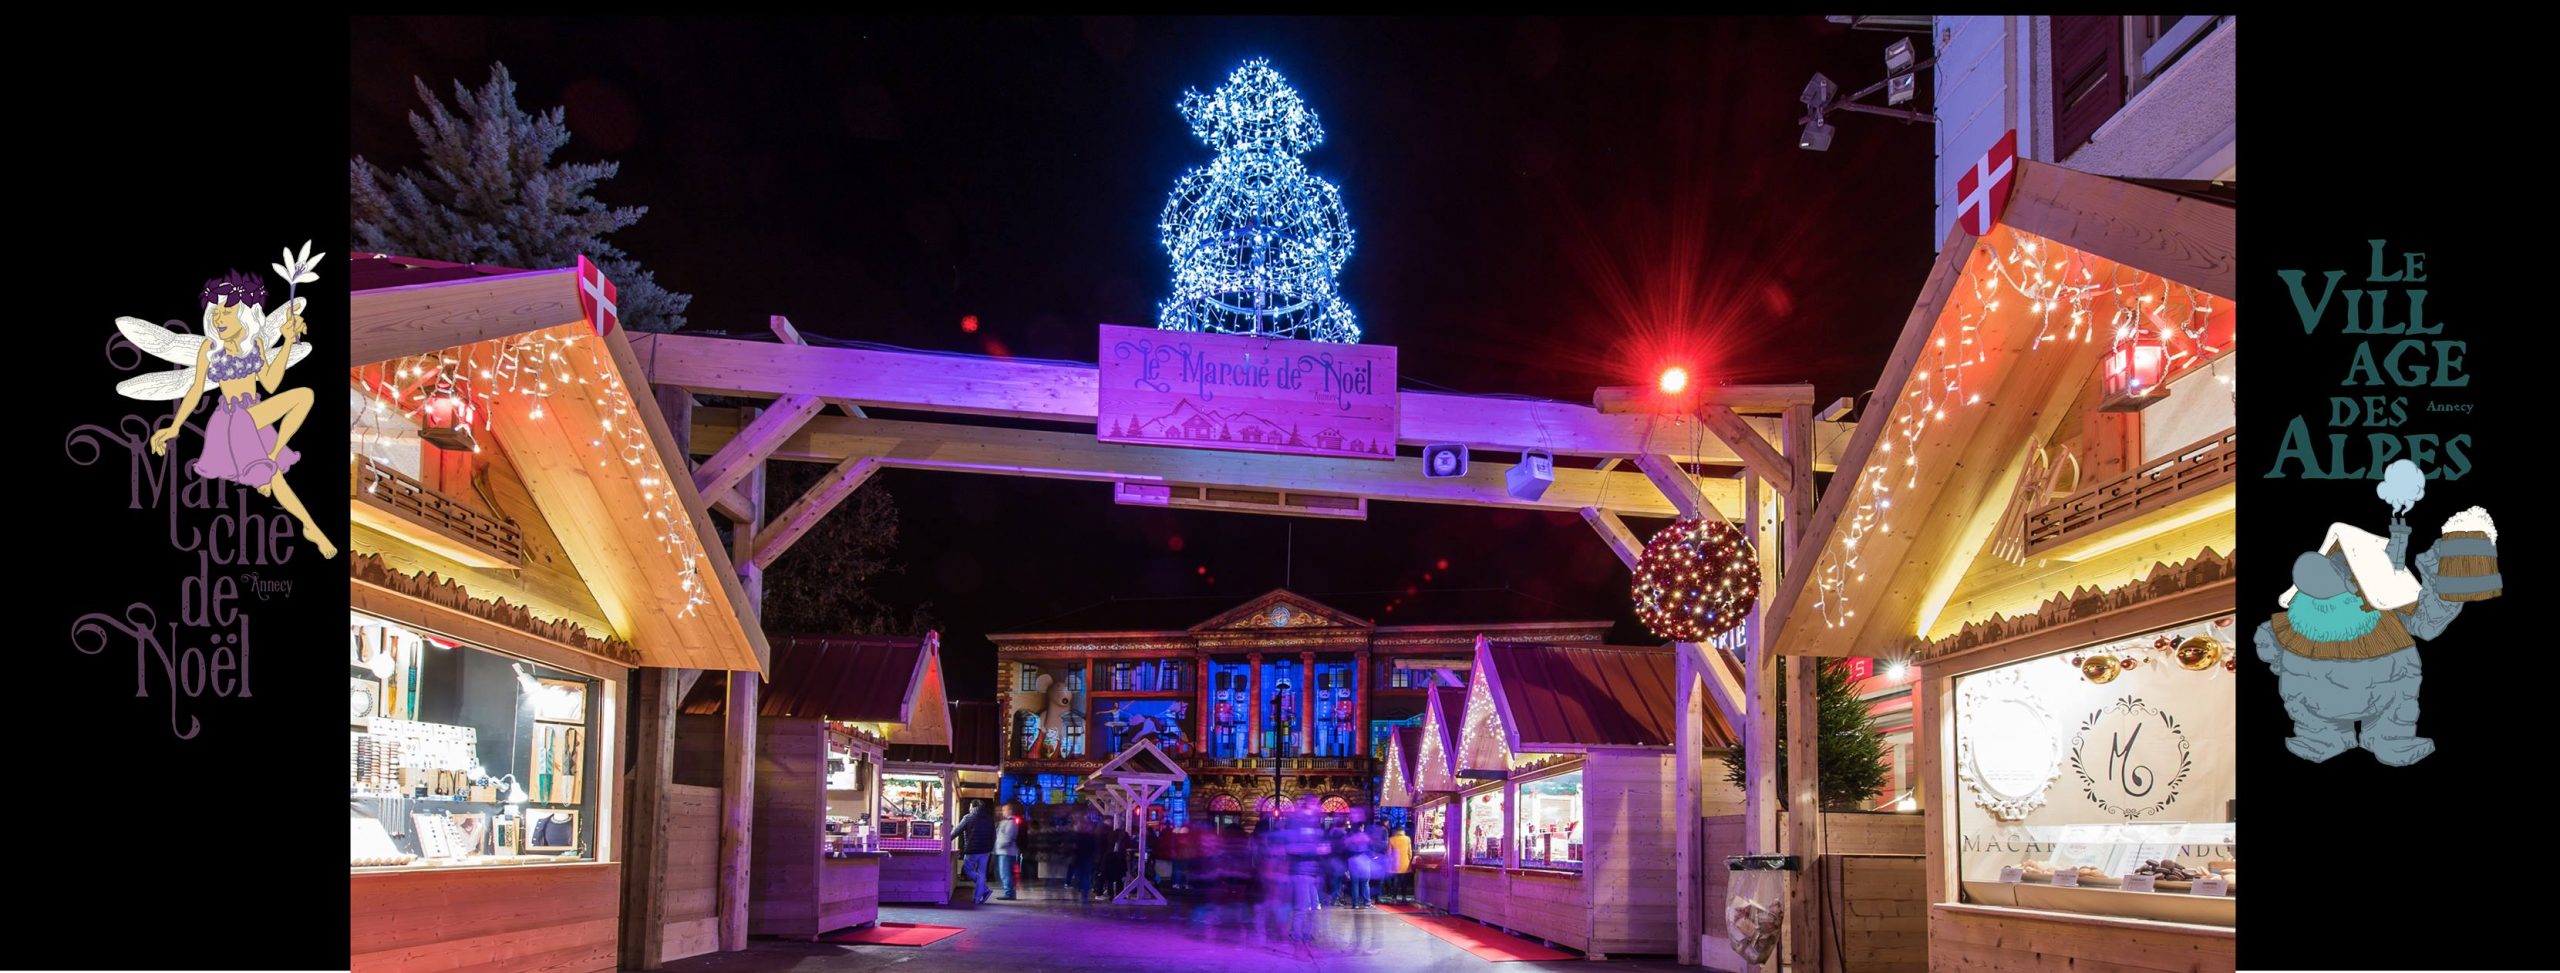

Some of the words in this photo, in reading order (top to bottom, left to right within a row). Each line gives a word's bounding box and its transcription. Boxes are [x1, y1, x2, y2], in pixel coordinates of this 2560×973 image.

[1114, 338, 1171, 393] Le
[1155, 342, 1270, 402] Marché
[1277, 356, 1302, 390] de
[1298, 352, 1372, 411] Noël
